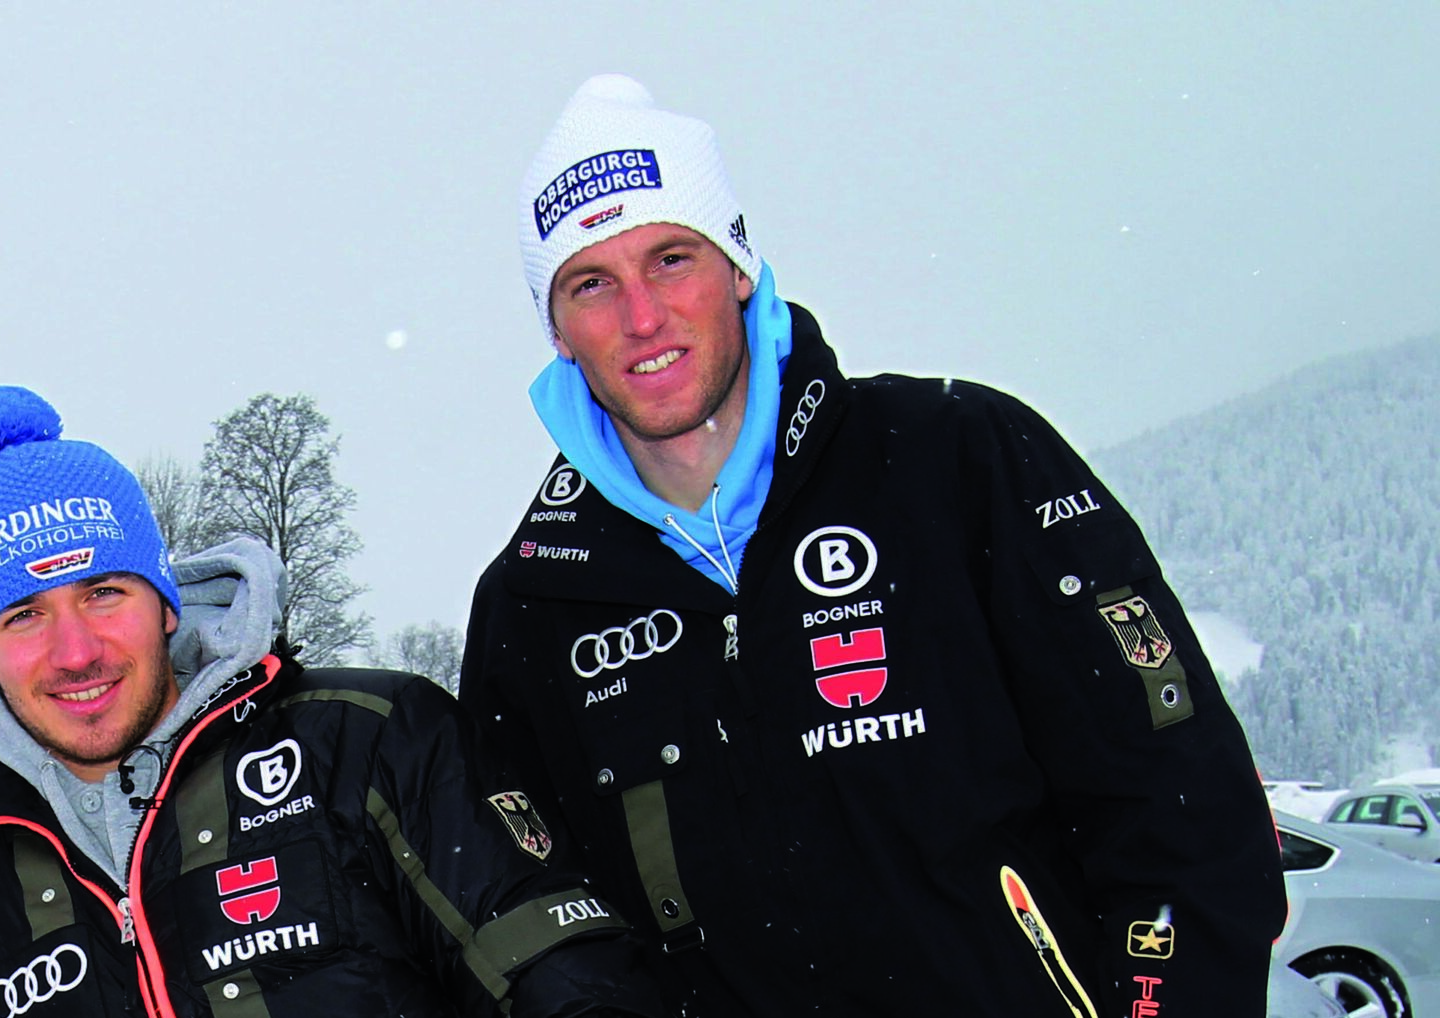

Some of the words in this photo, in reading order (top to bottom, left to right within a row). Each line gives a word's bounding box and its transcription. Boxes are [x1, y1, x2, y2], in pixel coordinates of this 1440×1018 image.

[538, 152, 651, 213] OBERGURGL
[541, 169, 656, 233] HOCHGURGL
[530, 511, 576, 522] BOGNER
[1036, 489, 1100, 528] ZOLL
[537, 545, 590, 562] WÜRTH
[802, 600, 883, 628] BOGNER
[585, 677, 627, 707] Audi
[802, 708, 926, 757] WÜRTH
[240, 795, 315, 831] BOGNER
[548, 899, 610, 926] ZOLL
[202, 922, 319, 971] WÜRTH
